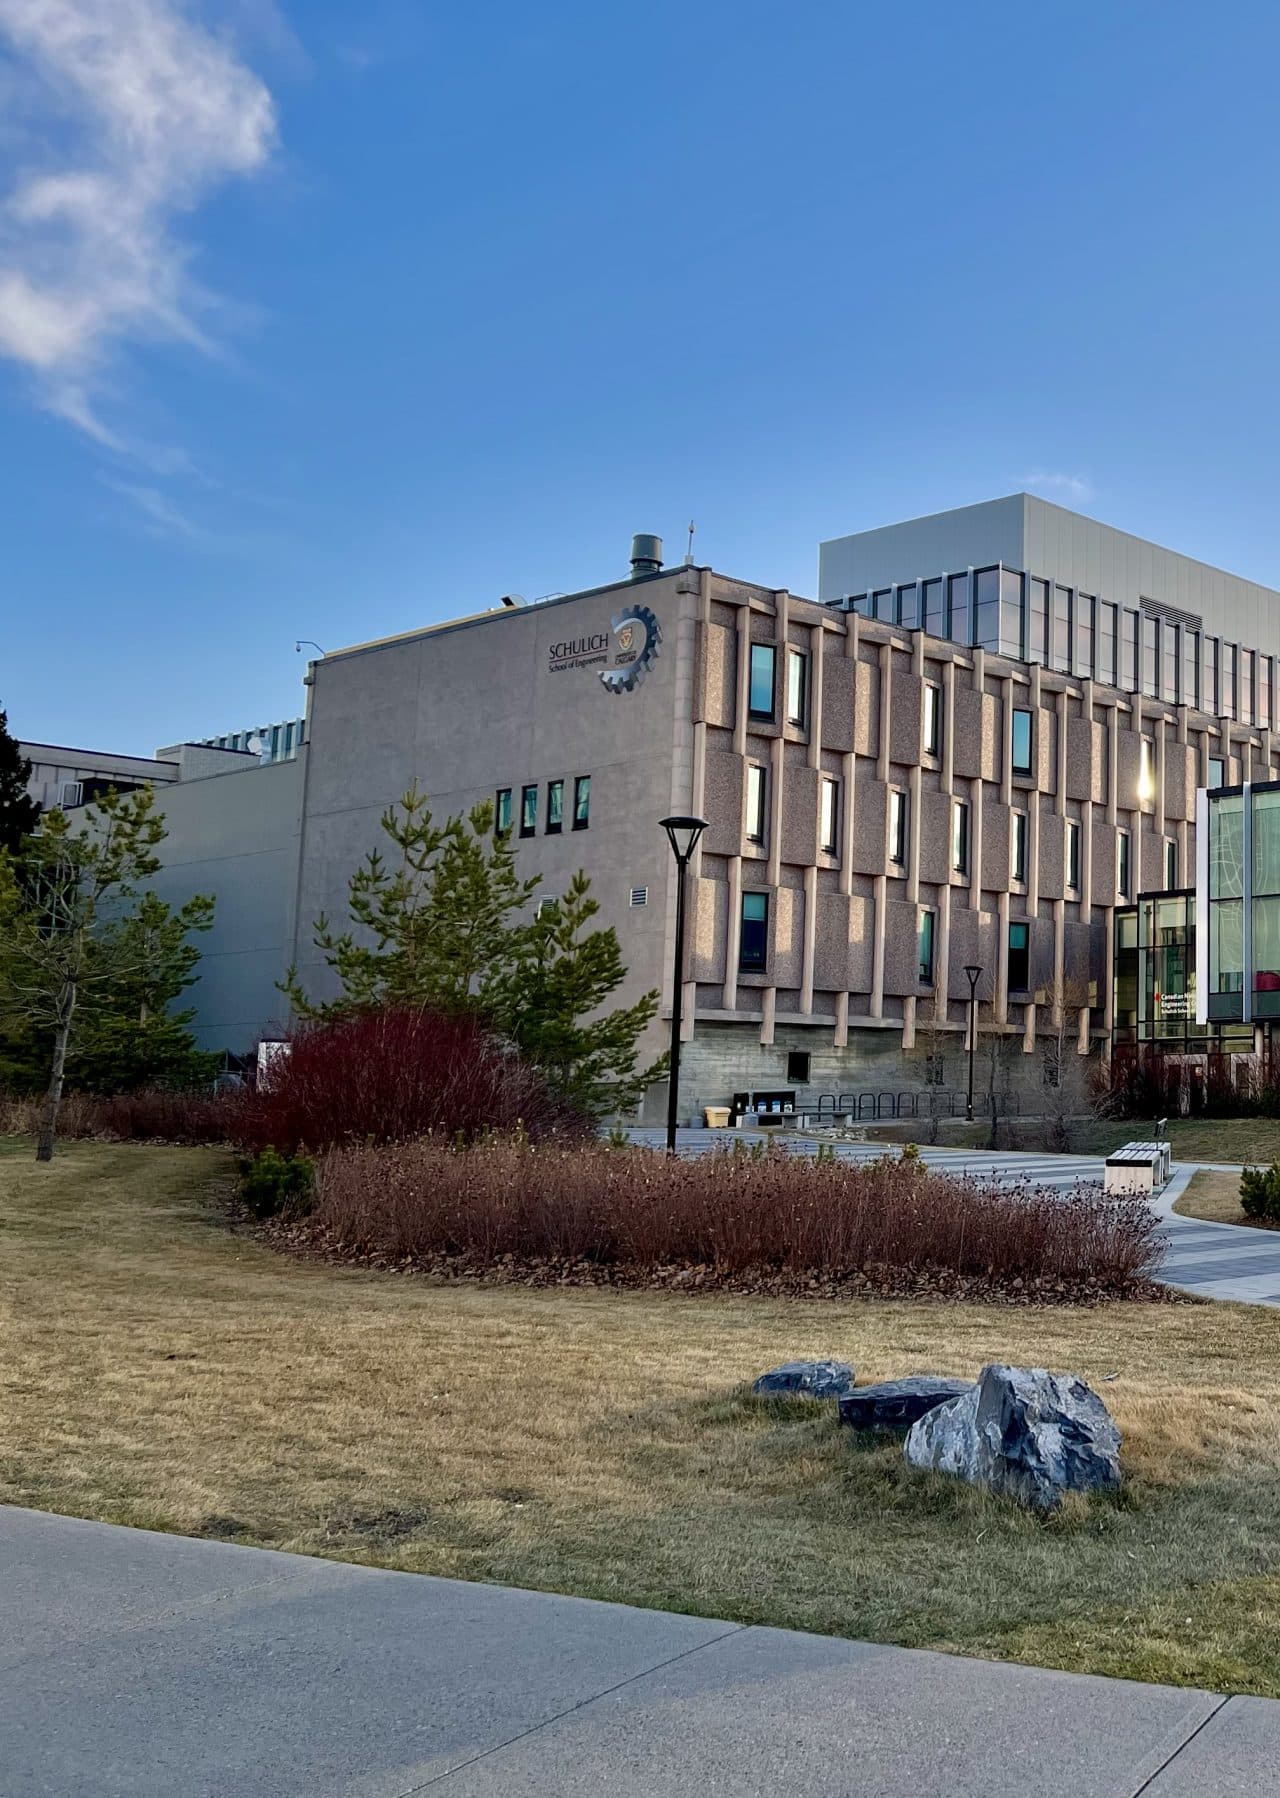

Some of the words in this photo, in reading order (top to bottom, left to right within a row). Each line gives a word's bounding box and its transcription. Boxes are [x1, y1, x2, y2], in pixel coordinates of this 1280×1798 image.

[549, 633, 609, 659] SCHULICH
[549, 660, 568, 674] School
[575, 654, 608, 669] Engineering
